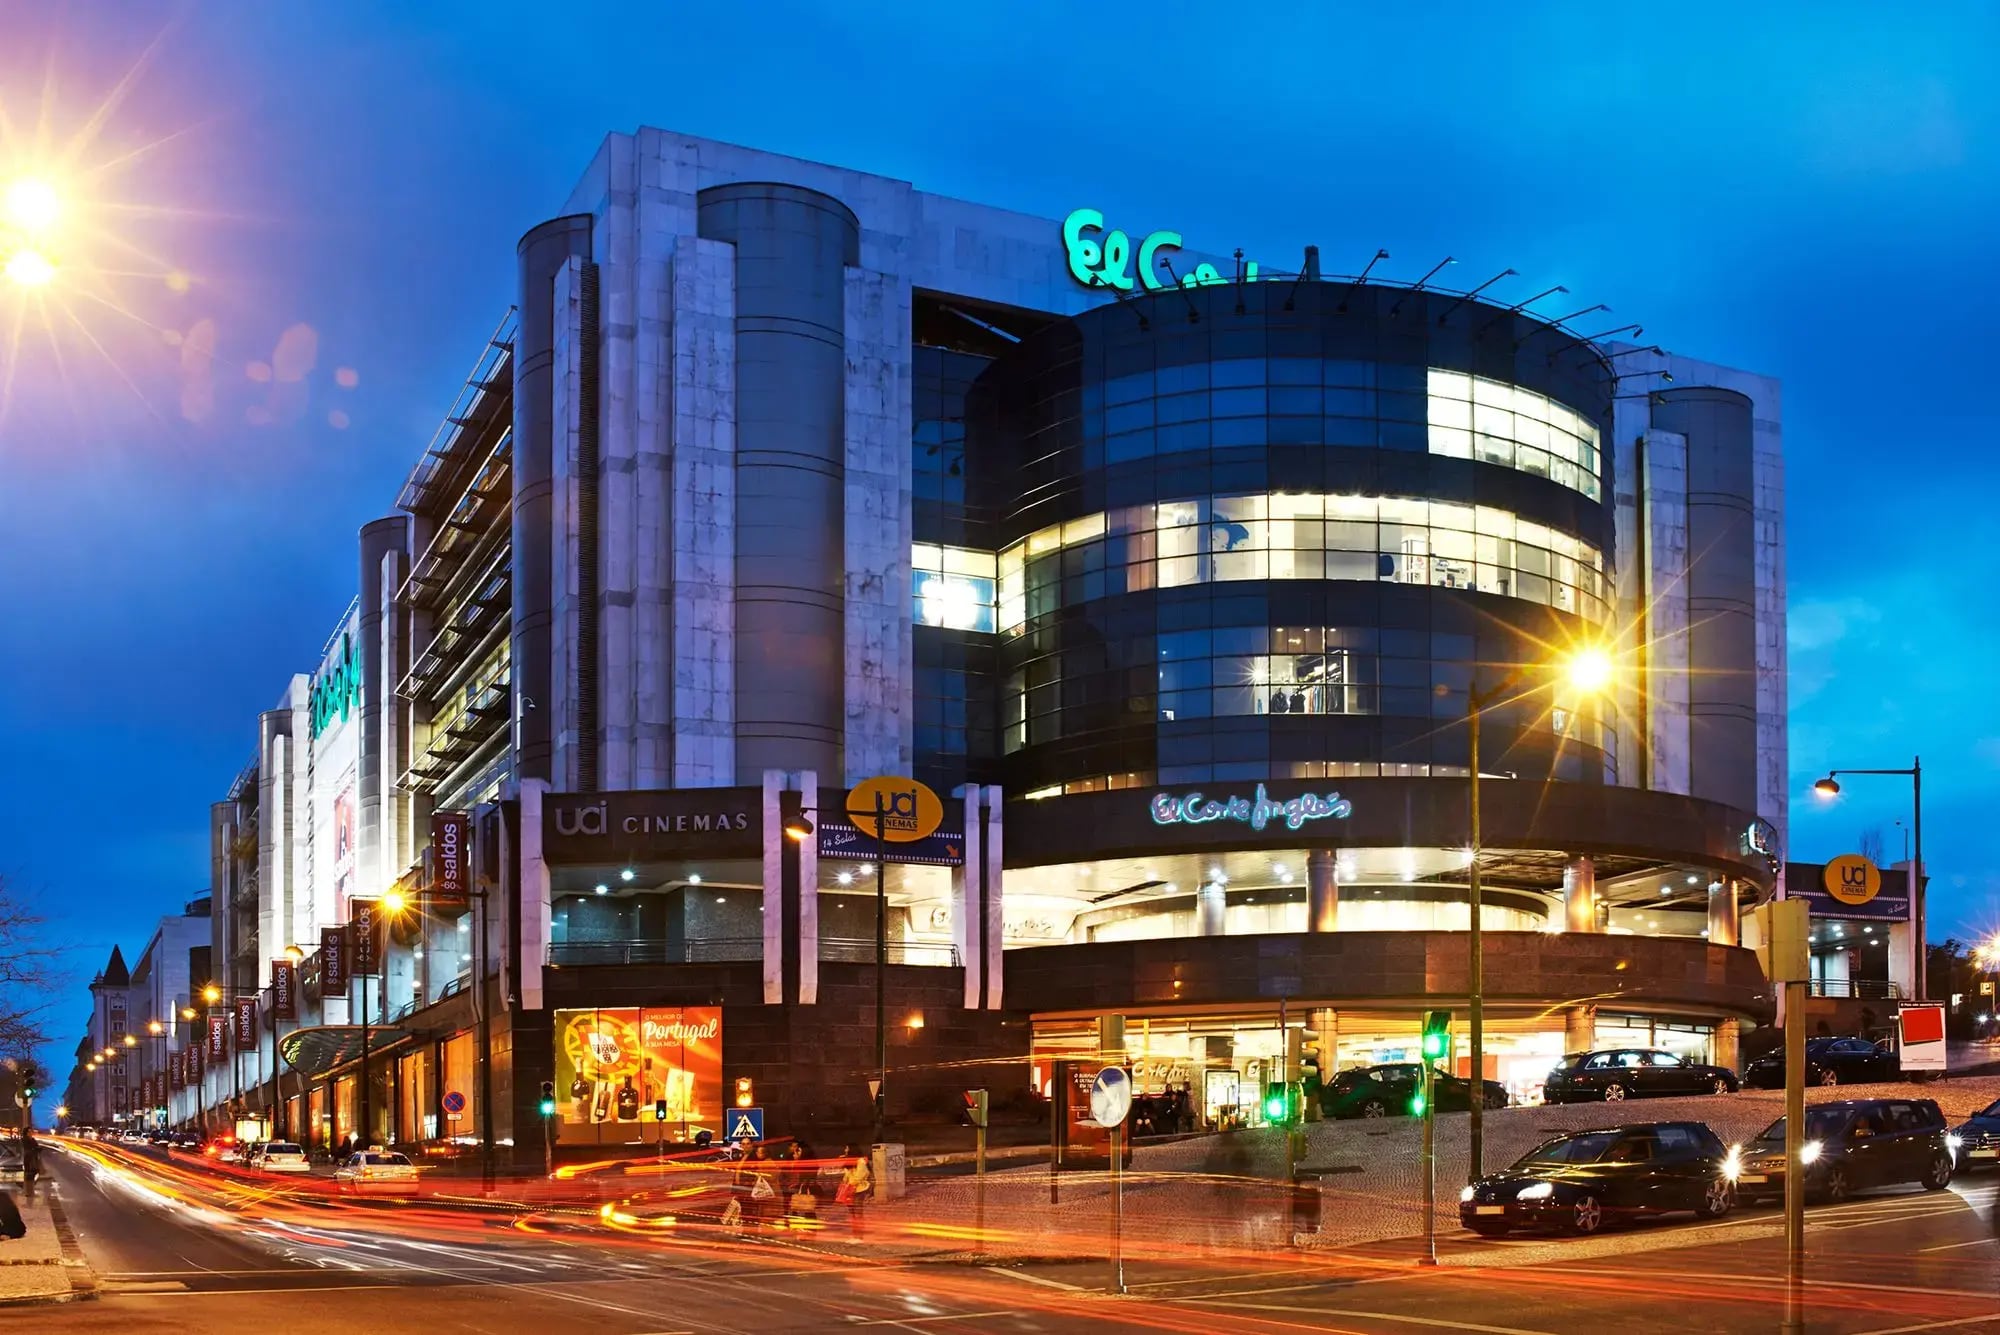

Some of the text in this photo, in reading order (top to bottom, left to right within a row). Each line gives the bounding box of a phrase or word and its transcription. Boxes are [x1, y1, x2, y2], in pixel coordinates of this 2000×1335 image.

[1063, 208, 1134, 291] El
[622, 812, 749, 835] CINEMAS
[1152, 793, 1181, 824] El
[1182, 792, 1250, 823] Corte
[441, 823, 457, 880] saldos
[834, 832, 857, 847] Salas
[1841, 886, 1866, 894] CINEMAS
[326, 935, 338, 977] saldos
[276, 967, 287, 1003] saldos
[212, 1022, 221, 1051] saldos
[240, 1005, 250, 1038] saldos
[644, 1018, 718, 1047] Portugal
